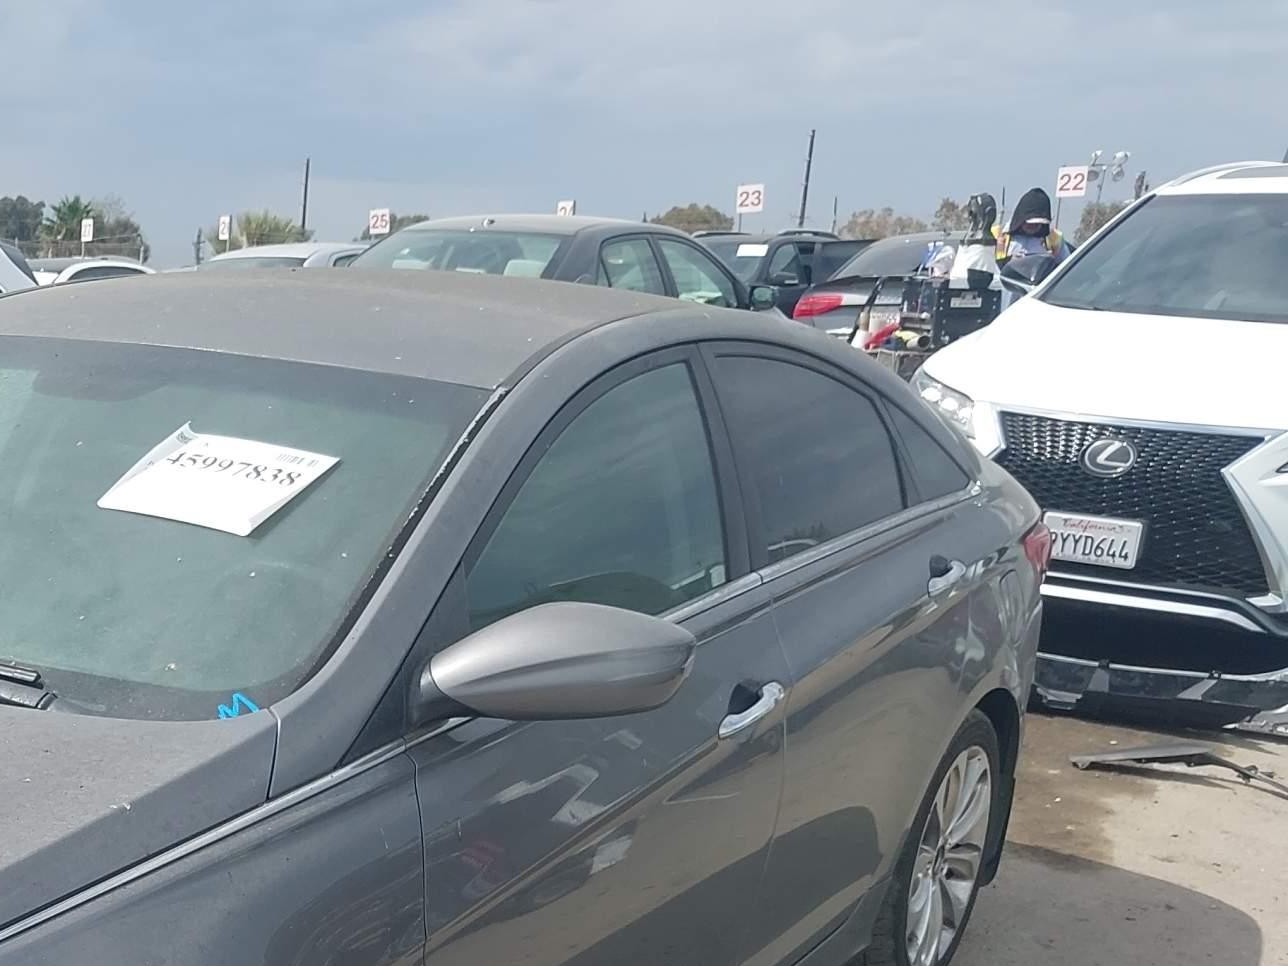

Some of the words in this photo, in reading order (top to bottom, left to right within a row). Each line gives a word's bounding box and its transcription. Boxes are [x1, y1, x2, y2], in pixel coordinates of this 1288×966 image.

[1058, 173, 1085, 191] 22
[738, 190, 761, 207] 23
[371, 214, 388, 229] 25
[165, 450, 302, 487] 45997838
